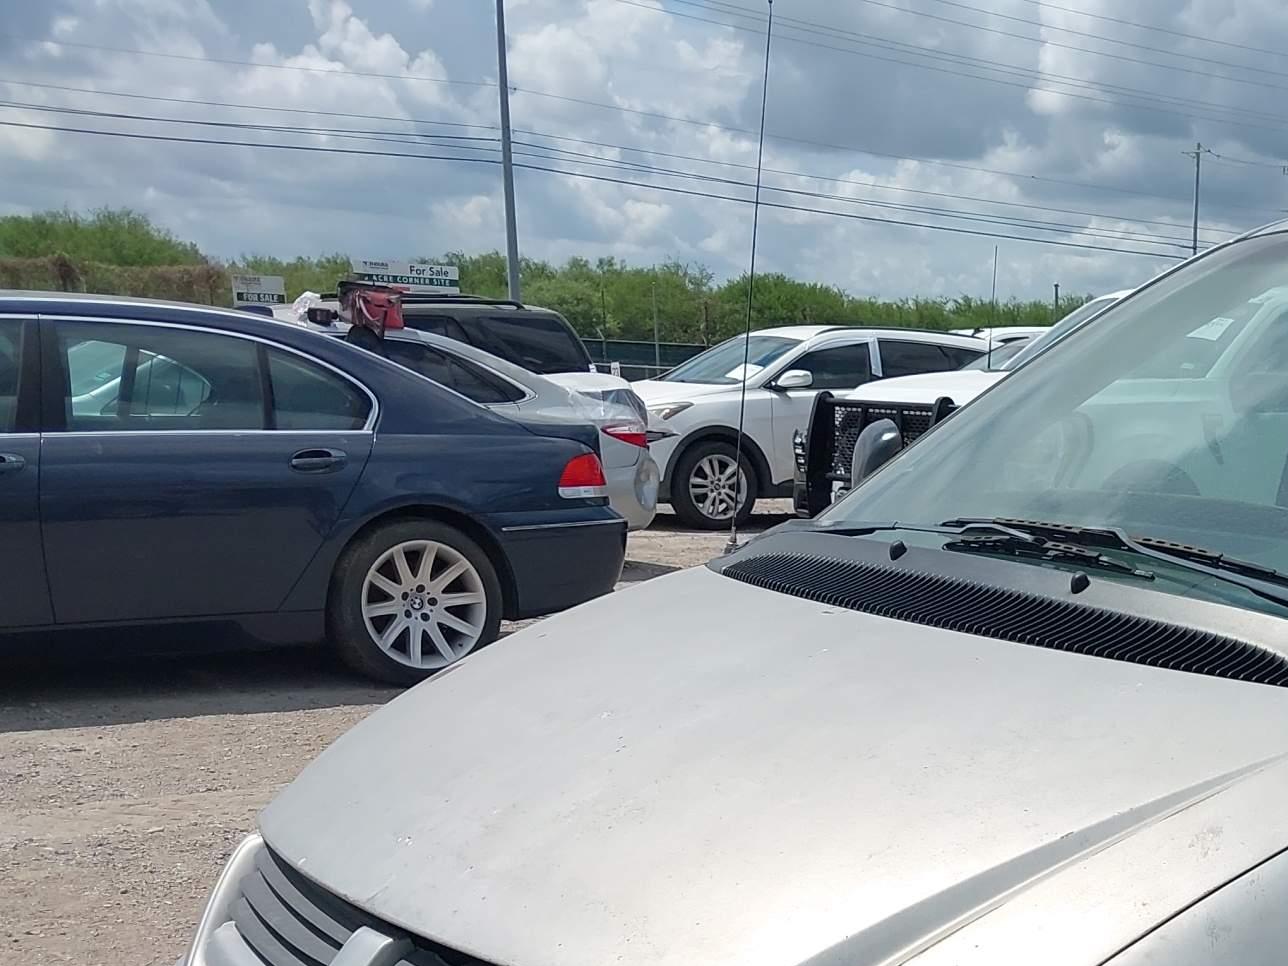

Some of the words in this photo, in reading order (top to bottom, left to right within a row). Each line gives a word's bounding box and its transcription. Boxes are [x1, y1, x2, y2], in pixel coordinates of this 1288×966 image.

[409, 265, 426, 276] For
[429, 266, 449, 278] Sale
[397, 276, 430, 285] CORNER
[432, 278, 451, 287] SITE
[243, 293, 259, 302] FOR
[259, 294, 280, 303] SALE
